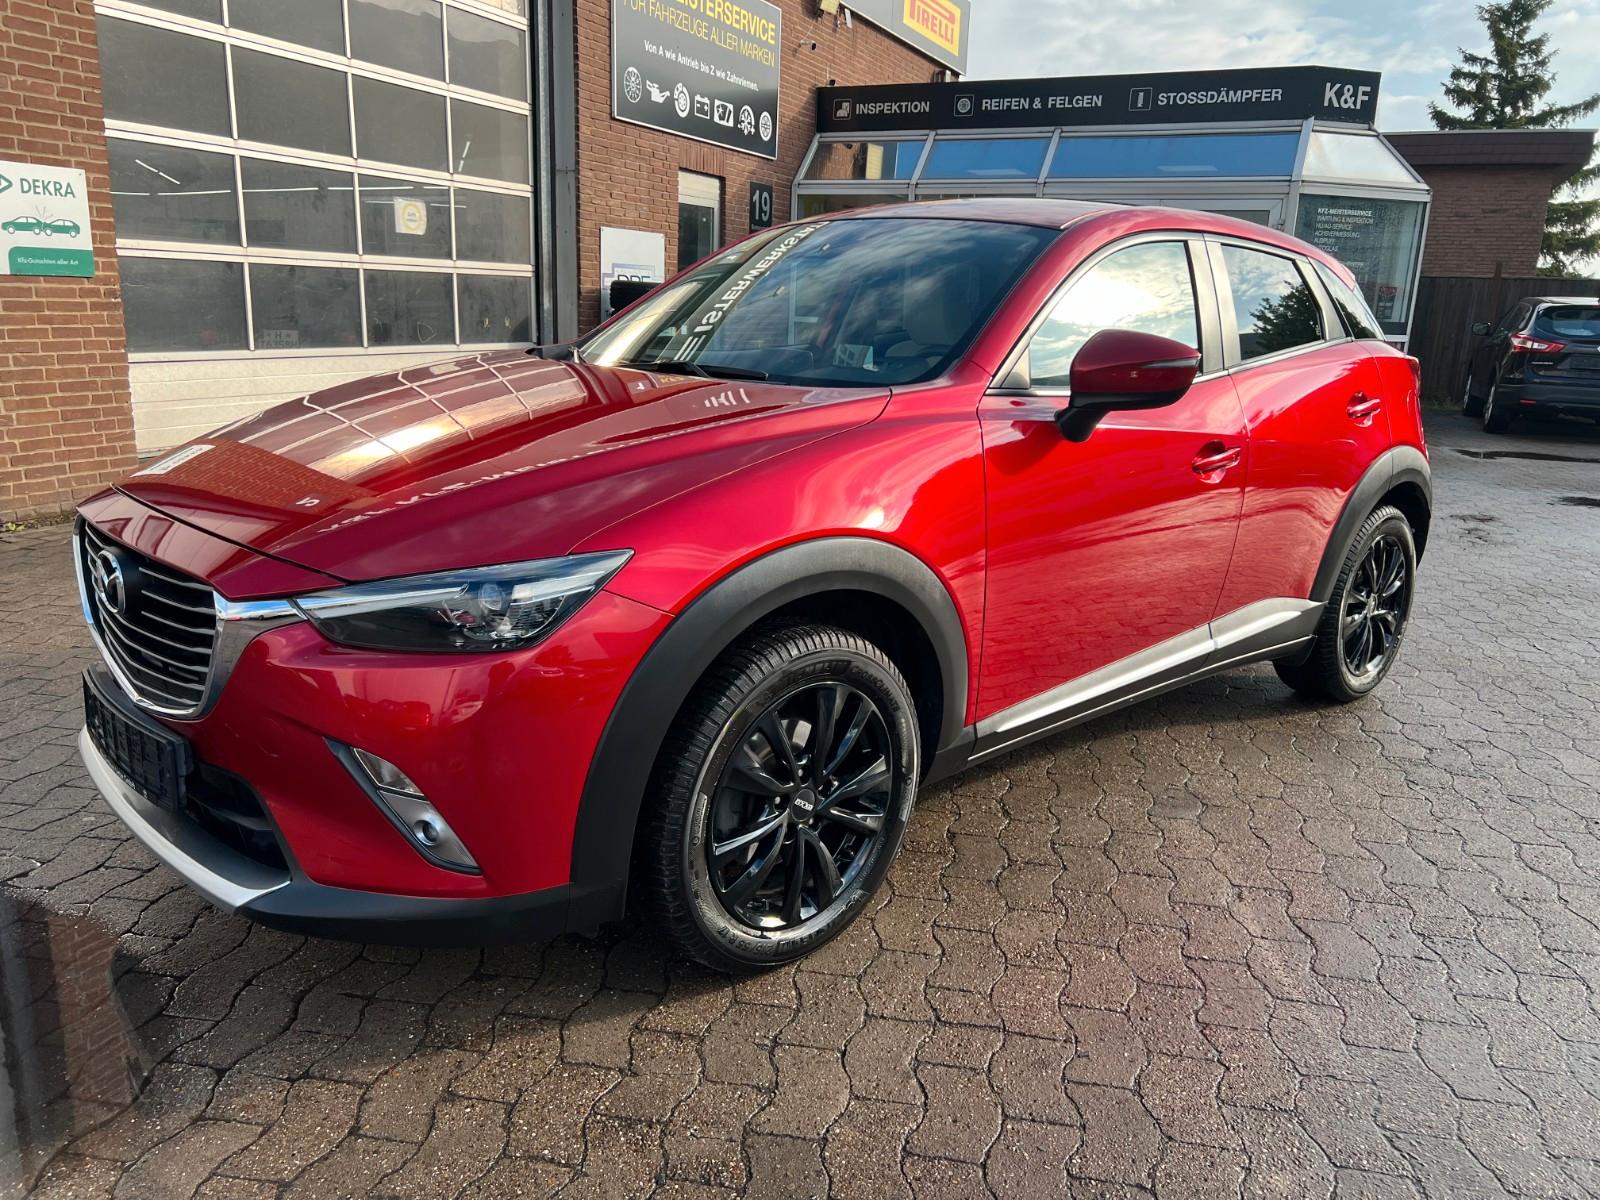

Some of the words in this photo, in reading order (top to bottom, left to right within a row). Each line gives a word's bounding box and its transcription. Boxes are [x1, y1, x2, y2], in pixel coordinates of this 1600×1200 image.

[649, 0, 709, 40] FAHRZEUGE
[710, 26, 739, 53] ALLER
[740, 38, 775, 67] MARKEN
[676, 0, 776, 45] TERSERVICE
[909, 0, 956, 46] PIRELLI
[644, 40, 657, 54] Von
[658, 45, 664, 56] A
[664, 49, 677, 61] wie
[677, 53, 700, 70] Antrieb
[700, 61, 710, 74] bis
[710, 65, 715, 76] Z
[715, 69, 726, 80] wie
[855, 101, 930, 115] INSPEKTION
[981, 98, 1030, 111] REIFEN
[1032, 100, 1042, 110] &
[1048, 94, 1103, 109] FELGEN
[1157, 87, 1283, 106] STOSSDÄMPFER
[1323, 82, 1372, 110] K&F
[19, 177, 76, 198] DEKRA
[752, 189, 771, 222] 19
